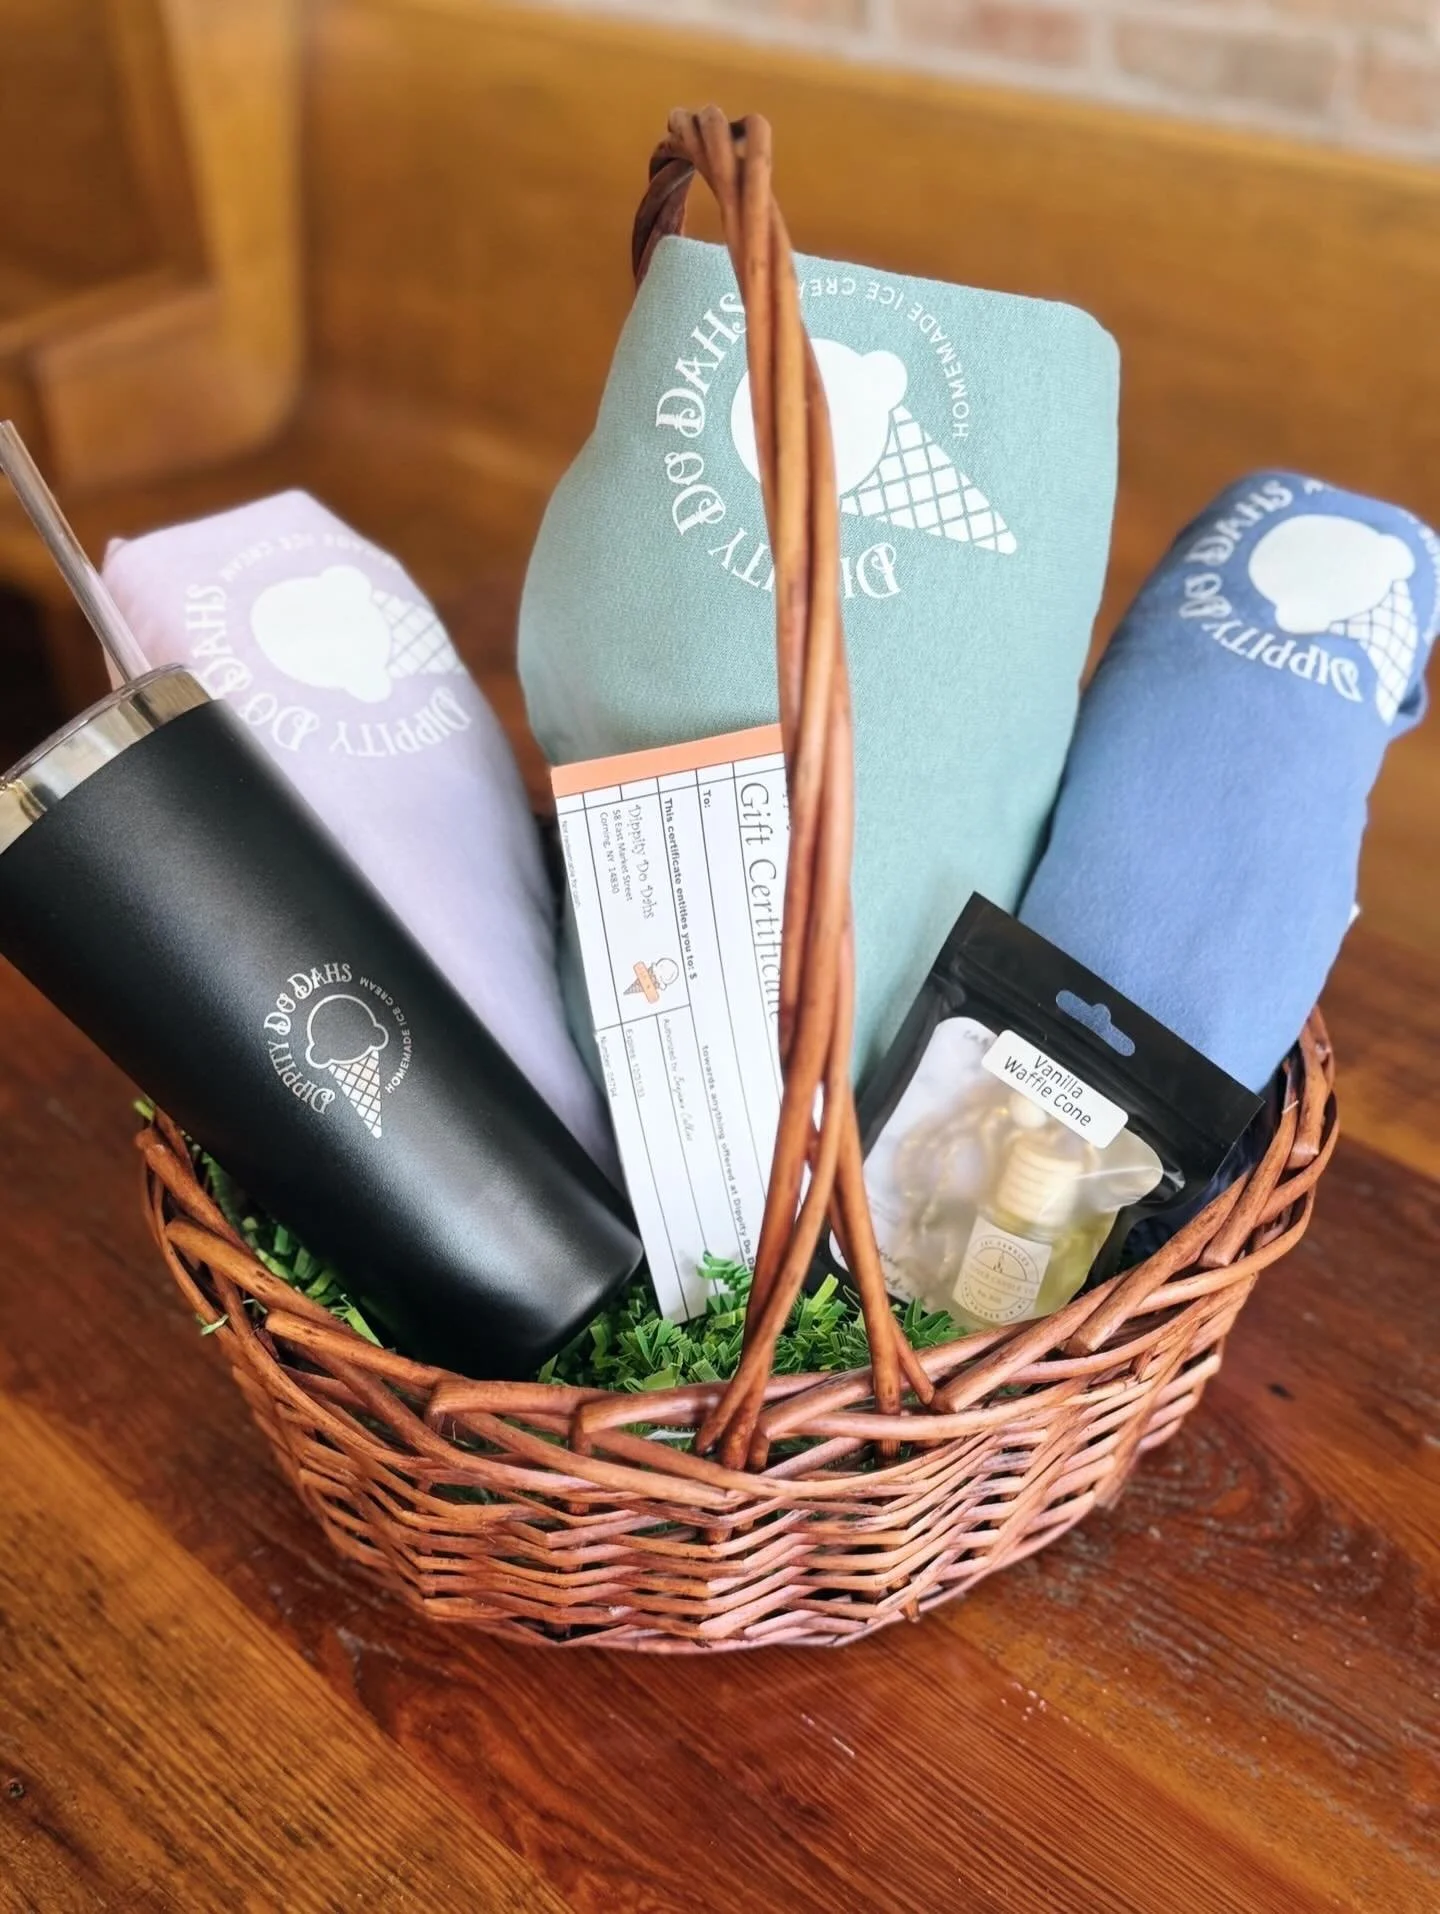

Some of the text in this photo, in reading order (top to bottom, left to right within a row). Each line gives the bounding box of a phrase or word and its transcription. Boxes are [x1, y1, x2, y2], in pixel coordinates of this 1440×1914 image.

[655, 292, 747, 438] DAHS
[797, 276, 970, 441] HOMEMADE ICE CRE
[664, 451, 726, 536] DO
[1179, 479, 1364, 703] DIPPITY DO DAHS
[185, 584, 473, 757] DIPPITY DO DAHS
[664, 797, 674, 823] This
[703, 789, 713, 809] To:
[740, 782, 774, 845] Gift
[607, 850, 615, 862] NY
[612, 809, 633, 902] 58 East Market Street
[626, 804, 646, 856] Dippity
[636, 859, 649, 882] Do
[668, 826, 682, 885] certificate
[608, 867, 620, 894] 14830
[676, 887, 688, 930] entitles
[681, 931, 692, 953] you
[686, 951, 696, 970] to:
[264, 962, 353, 1114] DIPPITY DO DAHS
[359, 976, 412, 1094] HOMEMADE ICE CREAM
[702, 1045, 716, 1090] towards
[1004, 1055, 1092, 1126] Waffle Cone
[1034, 1055, 1084, 1099] Vanilla
[711, 1092, 726, 1140] anything
[721, 1143, 736, 1181] offered
[730, 1184, 739, 1196] at
[733, 1198, 747, 1237] Dippity
[743, 1239, 751, 1255] Do
